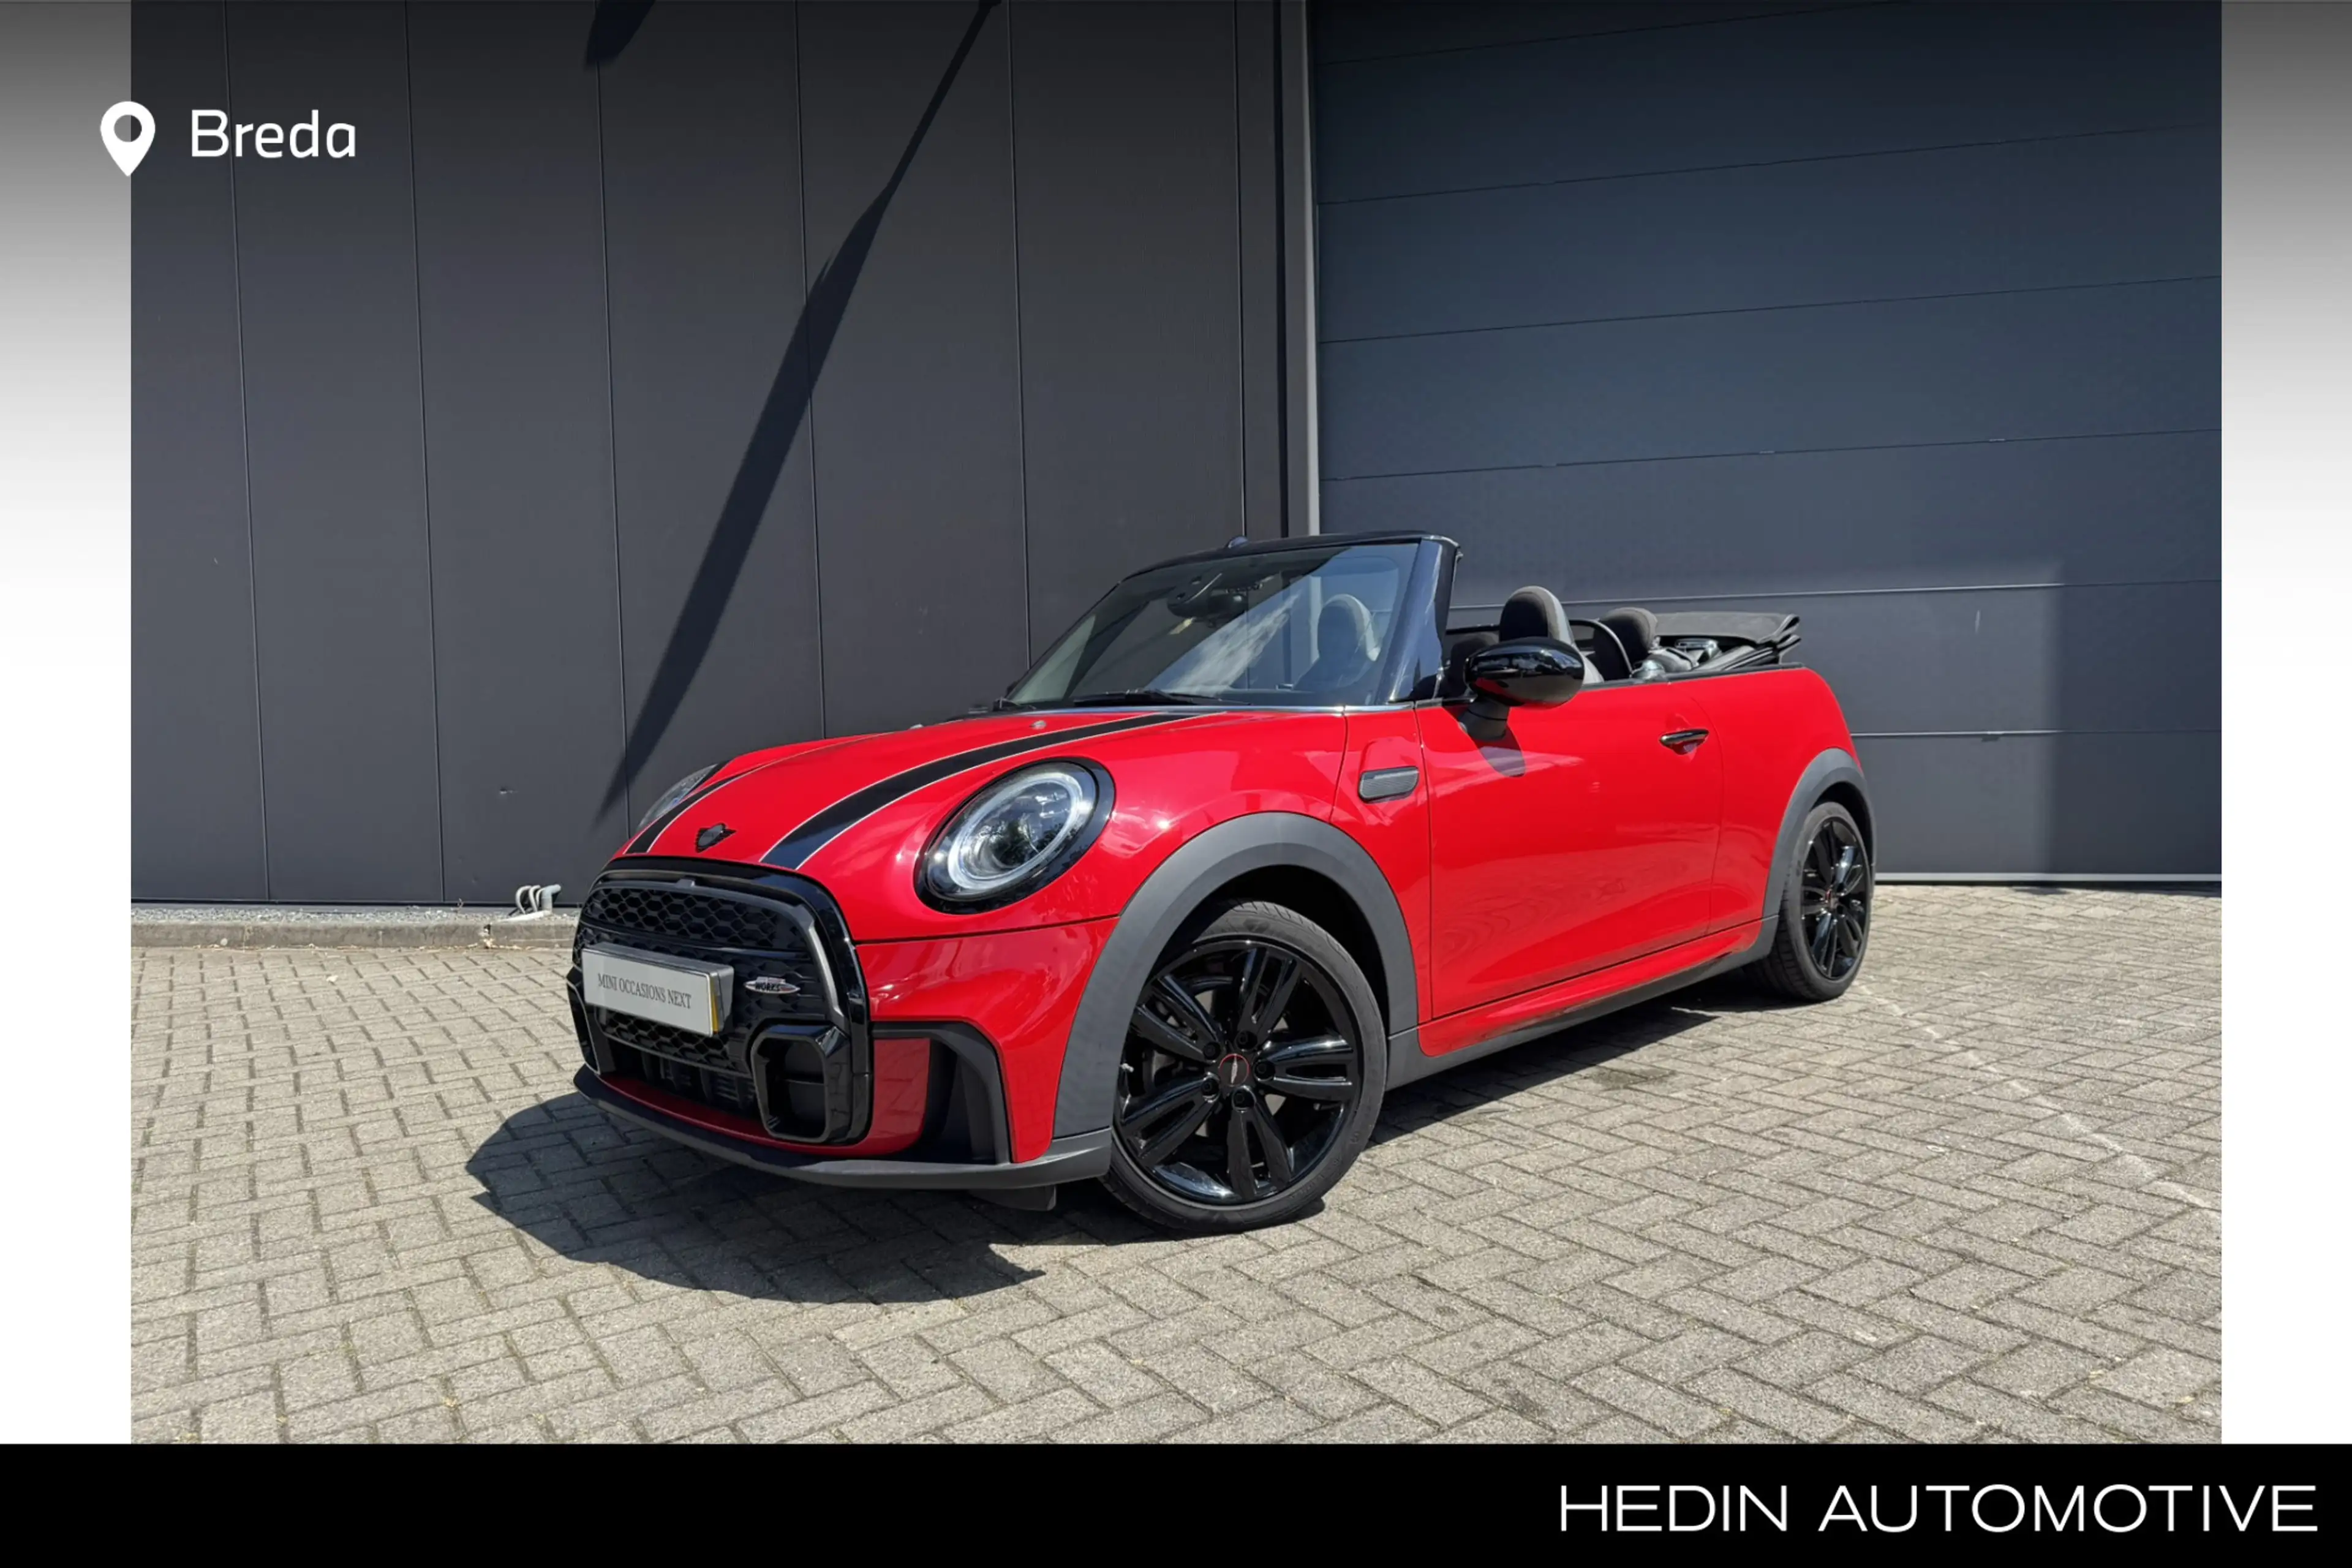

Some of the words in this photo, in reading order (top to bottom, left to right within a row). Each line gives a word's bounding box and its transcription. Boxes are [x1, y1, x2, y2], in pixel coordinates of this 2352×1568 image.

[598, 973, 617, 991] MINI
[619, 978, 666, 1003] OCCASIONS
[667, 989, 692, 1009] NEXT
